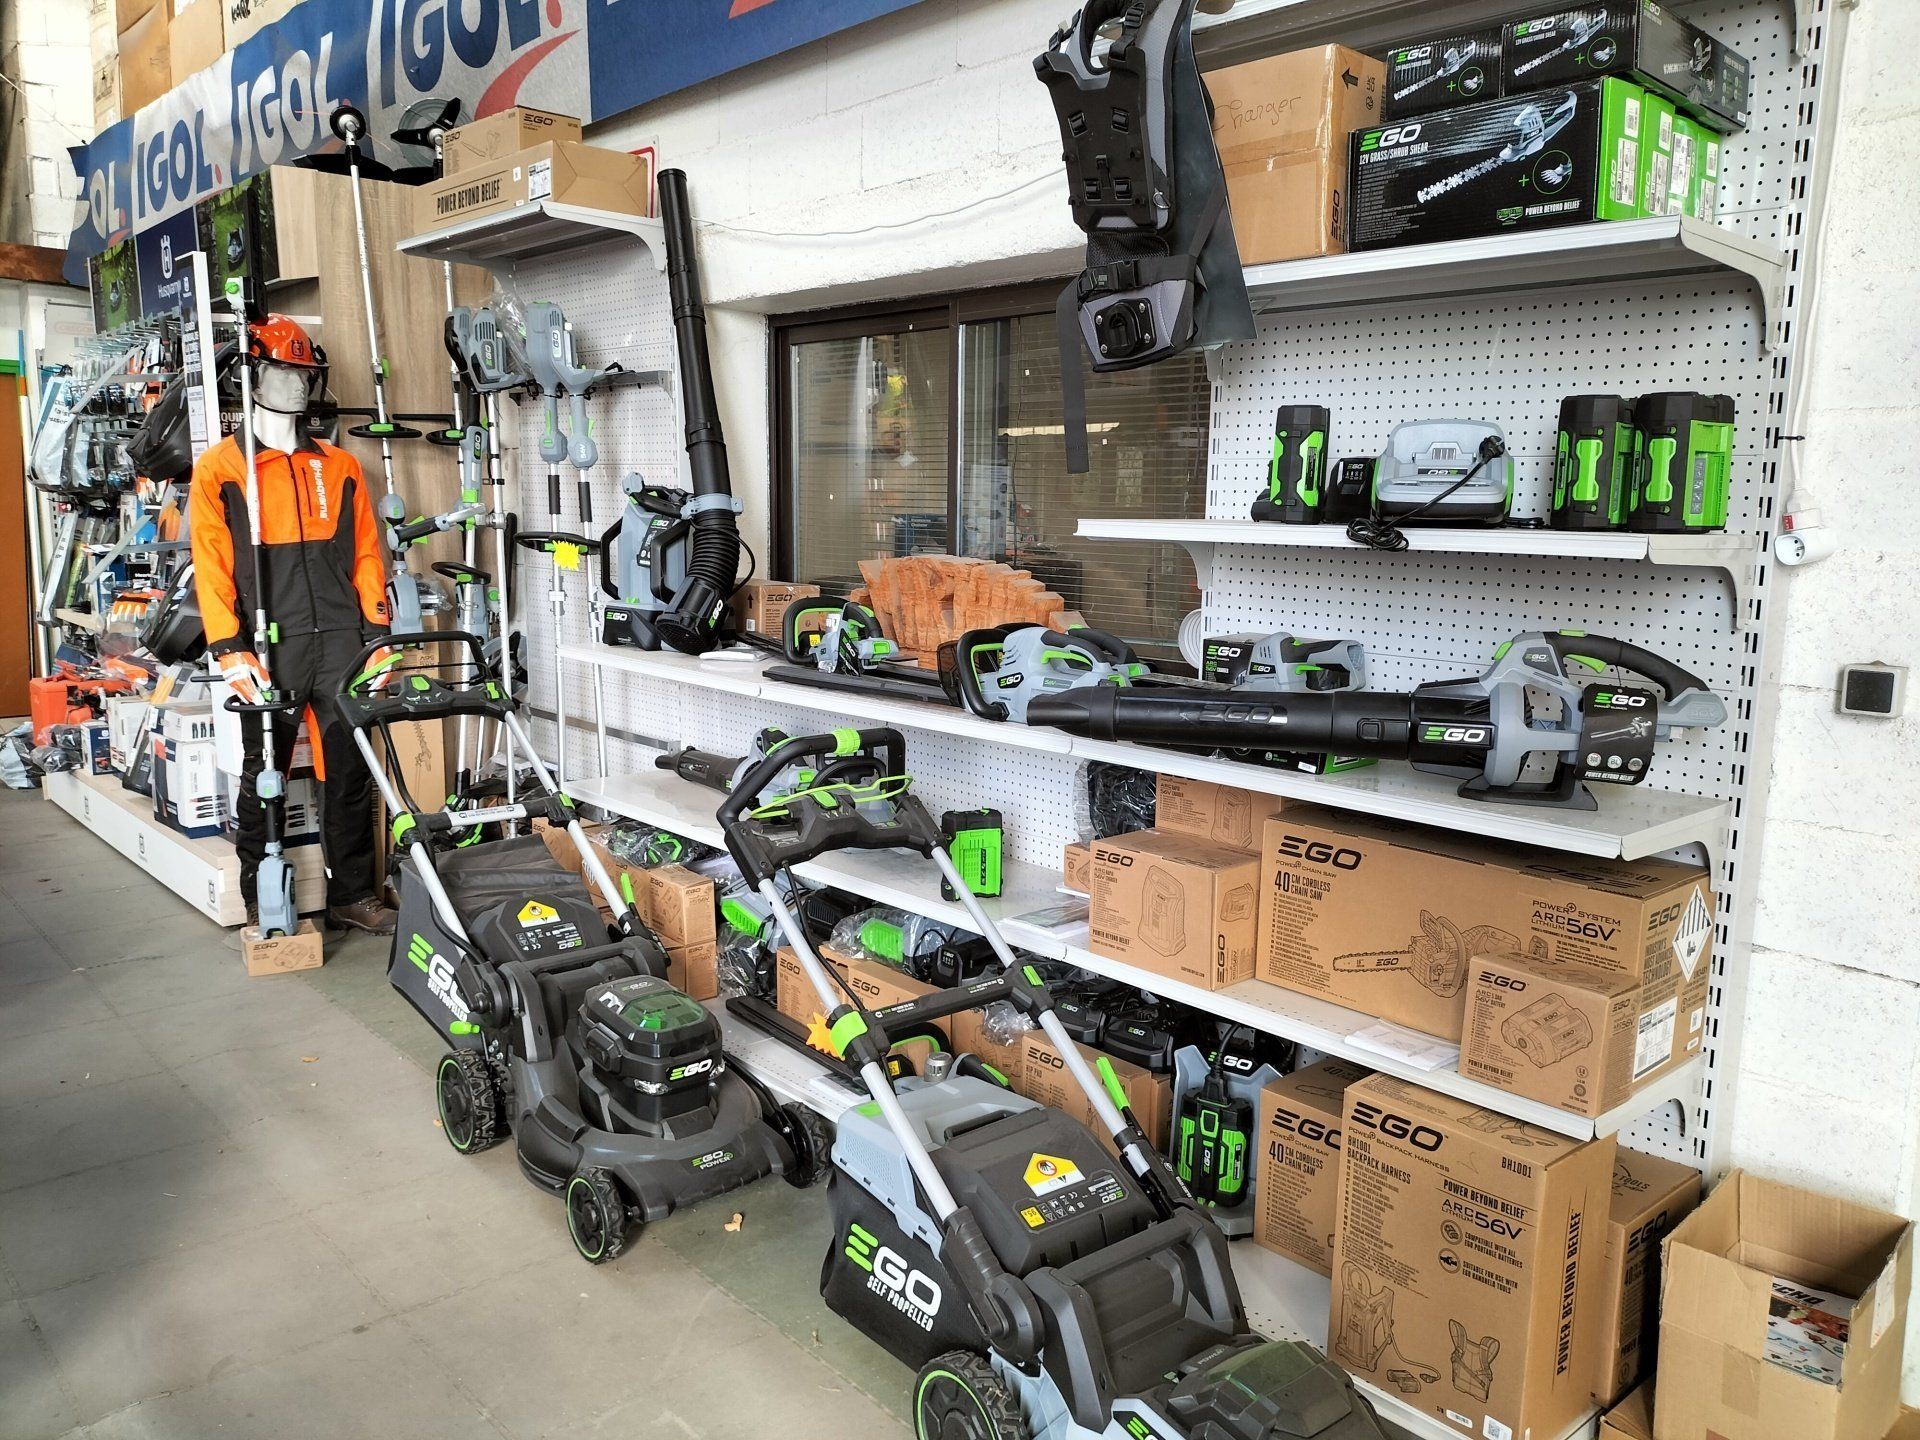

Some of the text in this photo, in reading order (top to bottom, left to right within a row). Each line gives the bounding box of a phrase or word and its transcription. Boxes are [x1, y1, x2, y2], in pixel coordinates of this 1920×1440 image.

[1515, 17, 1555, 37] EGO
[1396, 46, 1432, 63] EGO
[524, 113, 554, 126] EGO
[445, 131, 461, 144] EGO
[1360, 123, 1422, 152] EGO
[1360, 142, 1429, 165] 12V GRASS/SHRUB SHEAR
[437, 179, 501, 216] POWER BEYOND BELIEF
[1331, 189, 1341, 240] EGO
[652, 519, 669, 527] EGO
[766, 594, 793, 602] EGO
[606, 611, 628, 621] EGO
[708, 599, 724, 629] EGO
[1207, 645, 1241, 658] EGO
[1251, 664, 1271, 673] EGO
[1000, 675, 1021, 687] EGO
[1594, 692, 1647, 707] EGO
[1424, 726, 1486, 743] EGO
[1094, 849, 1134, 868] EGO
[1278, 835, 1362, 871] EGO
[1301, 865, 1322, 875] CHAIN
[649, 877, 664, 888] EGO
[1275, 870, 1290, 892] 40
[1291, 873, 1331, 893] CM CORDLESS
[1290, 884, 1323, 901] CHAIN SAW
[1532, 900, 1621, 926] POWER SYSTEM
[1647, 903, 1681, 931] EGO
[1531, 918, 1565, 931] LITHIUM
[253, 942, 279, 951] EGO
[779, 957, 801, 976] EGO
[1217, 934, 1226, 984] EGO
[1375, 957, 1399, 967] EGO
[852, 977, 880, 996] EGO
[1478, 970, 1527, 992] EGO
[1061, 1002, 1079, 1013] EGO
[1543, 1011, 1559, 1022] EGO
[1128, 1025, 1146, 1037] EGO
[1027, 1046, 1065, 1070] EGO
[669, 1058, 713, 1081] EGO
[1351, 1101, 1444, 1152] EGO
[1268, 1140, 1284, 1164] 40
[1347, 1135, 1371, 1155] BH1001
[1376, 1137, 1413, 1158] BACKPACK
[1414, 1153, 1450, 1173] HARNESS
[692, 1150, 724, 1167] EGO
[699, 1157, 731, 1170] POWER
[1203, 1148, 1211, 1174] EGO
[1284, 1156, 1316, 1176] CHAIN SAW
[1285, 1146, 1323, 1170] CM CORDLESS
[1347, 1146, 1412, 1185] BACKPACK HARNESS
[1501, 1156, 1532, 1179] BH1001
[1101, 1191, 1124, 1204] EGO
[1443, 1178, 1525, 1220] POWER BEYOND BELIEF
[1441, 1206, 1474, 1224] LITHIUM
[1627, 1210, 1668, 1254] EGO
[845, 1223, 942, 1317] EGO
[1556, 1210, 1581, 1376] POWER BEYOND BELIEF
[866, 1274, 935, 1333] SELF PROPELLED
